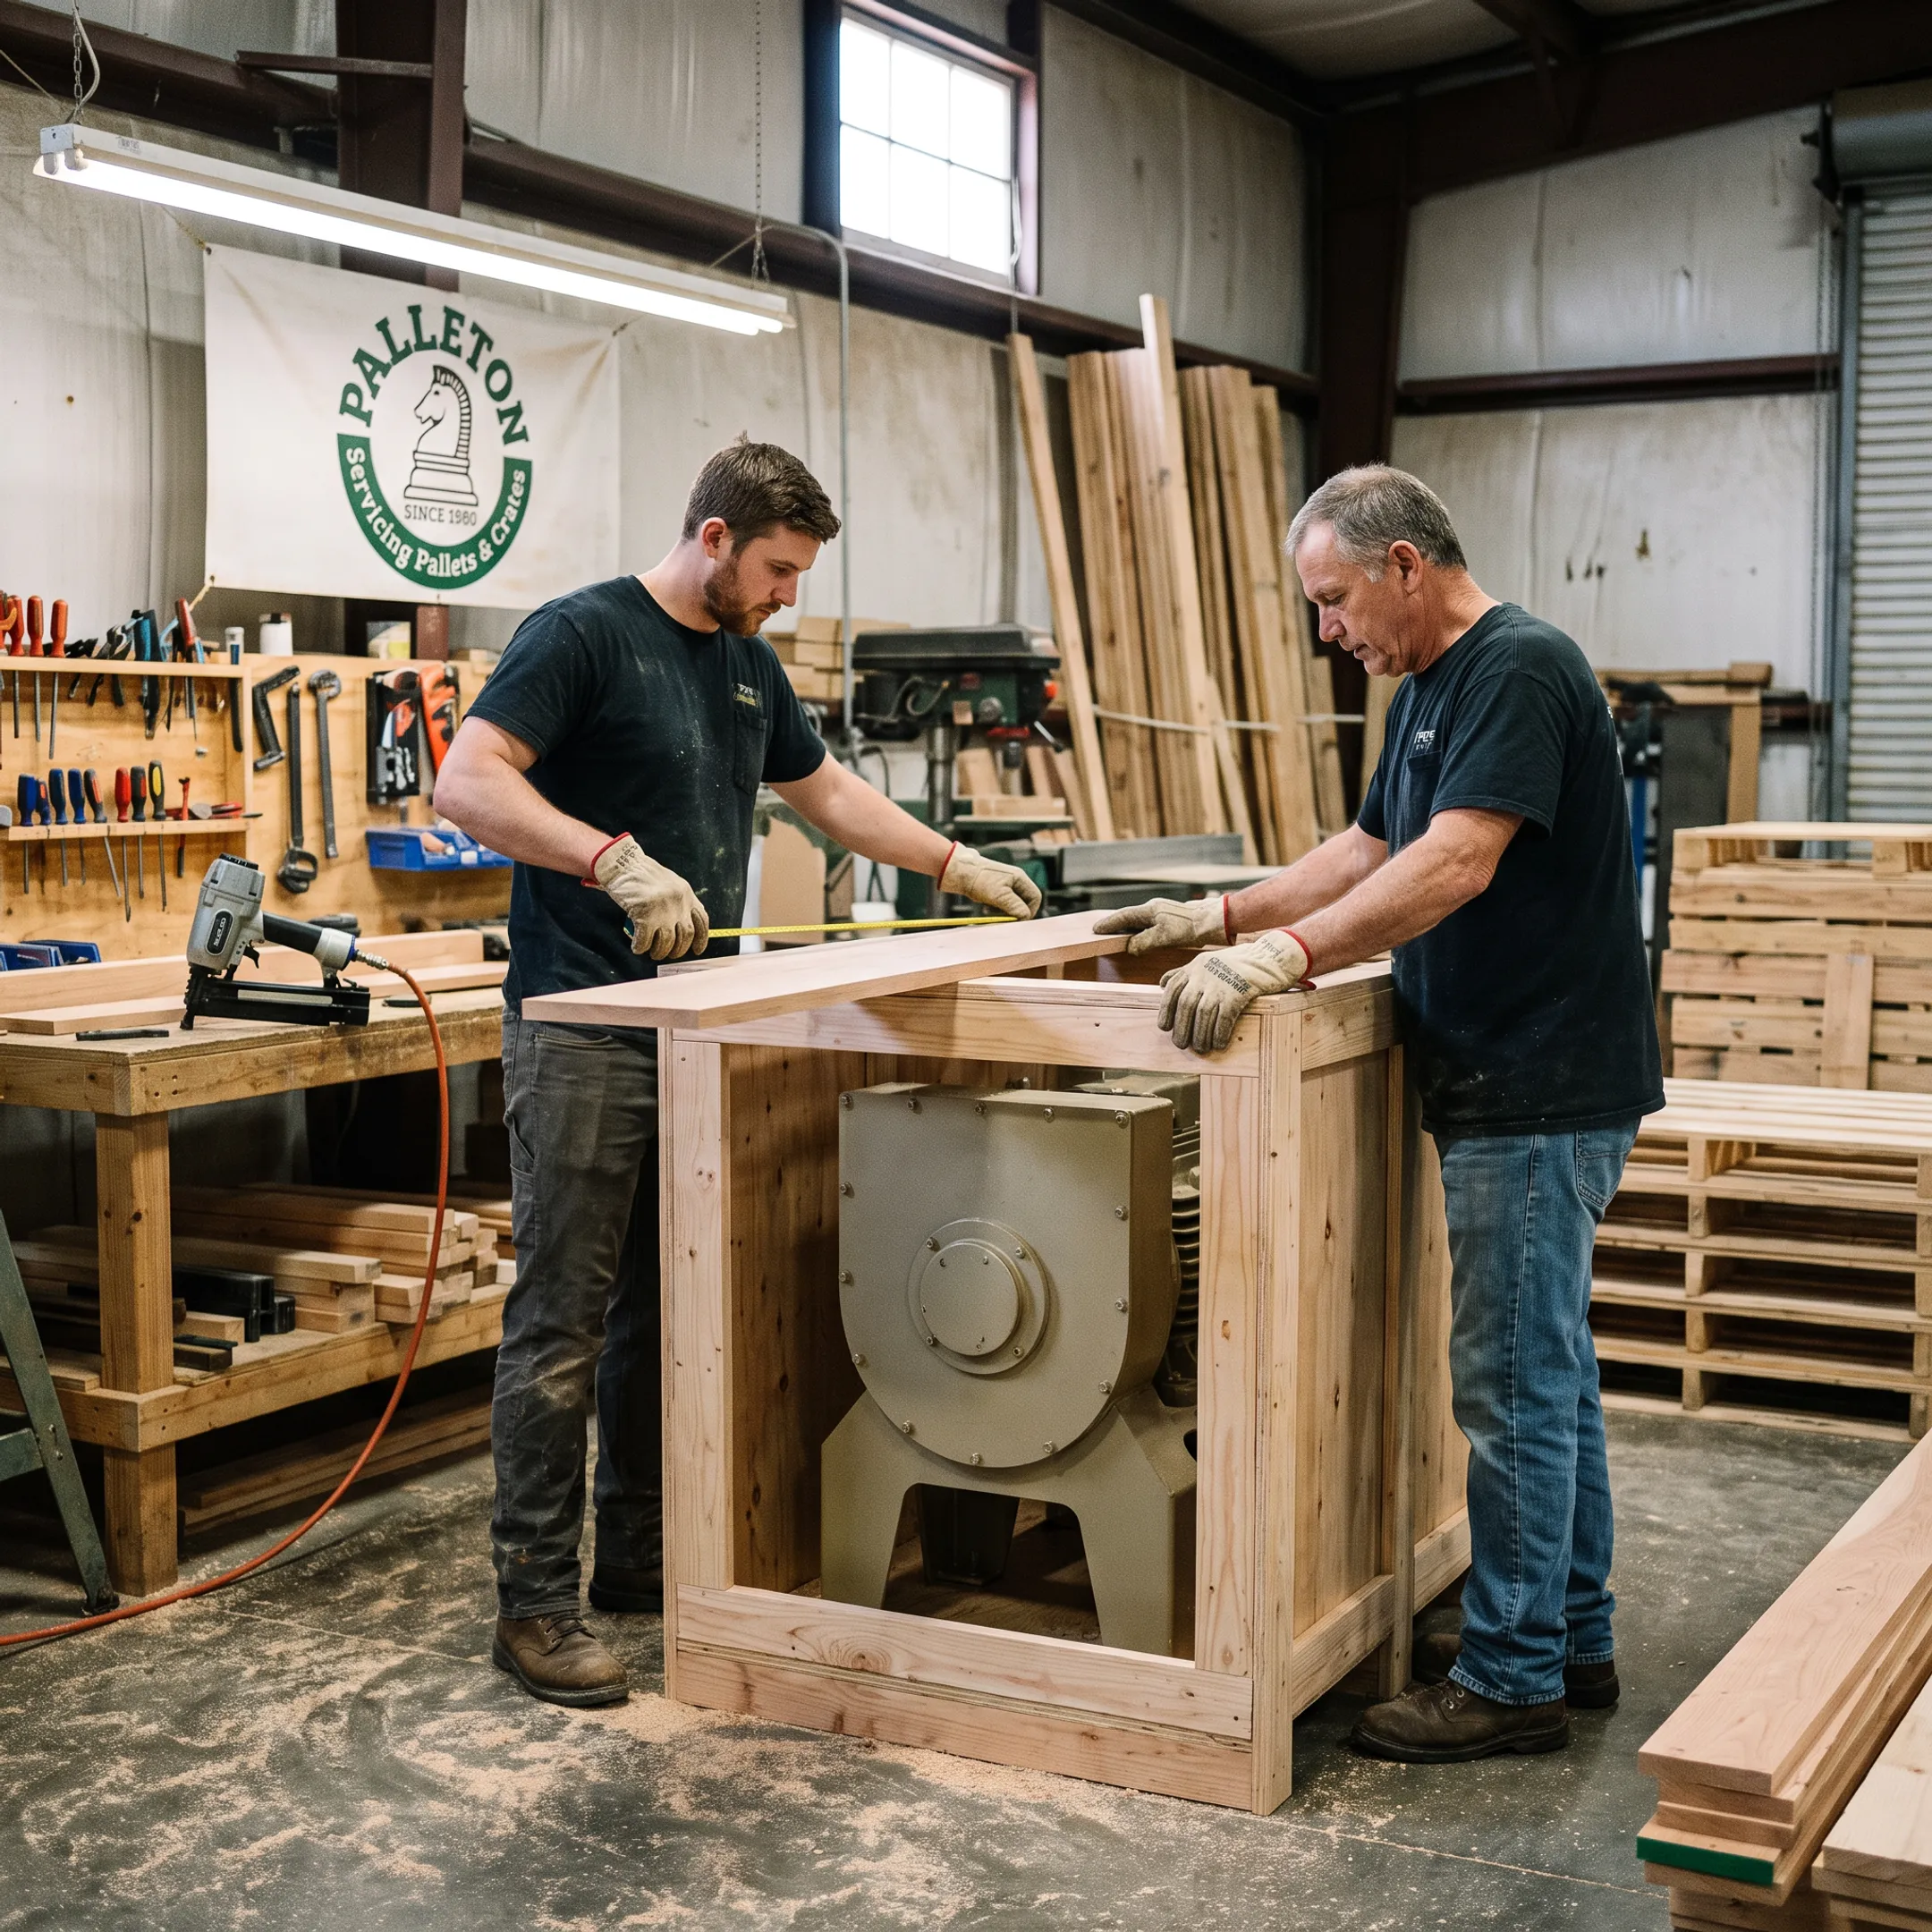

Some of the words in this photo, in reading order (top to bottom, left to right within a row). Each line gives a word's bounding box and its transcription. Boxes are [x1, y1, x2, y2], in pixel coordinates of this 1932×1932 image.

[339, 304, 530, 445] PALLETON
[346, 447, 413, 569] Servicing
[414, 547, 478, 578] Pallets
[479, 538, 494, 562] &
[491, 470, 526, 546] Crates
[404, 504, 445, 522] SINCE
